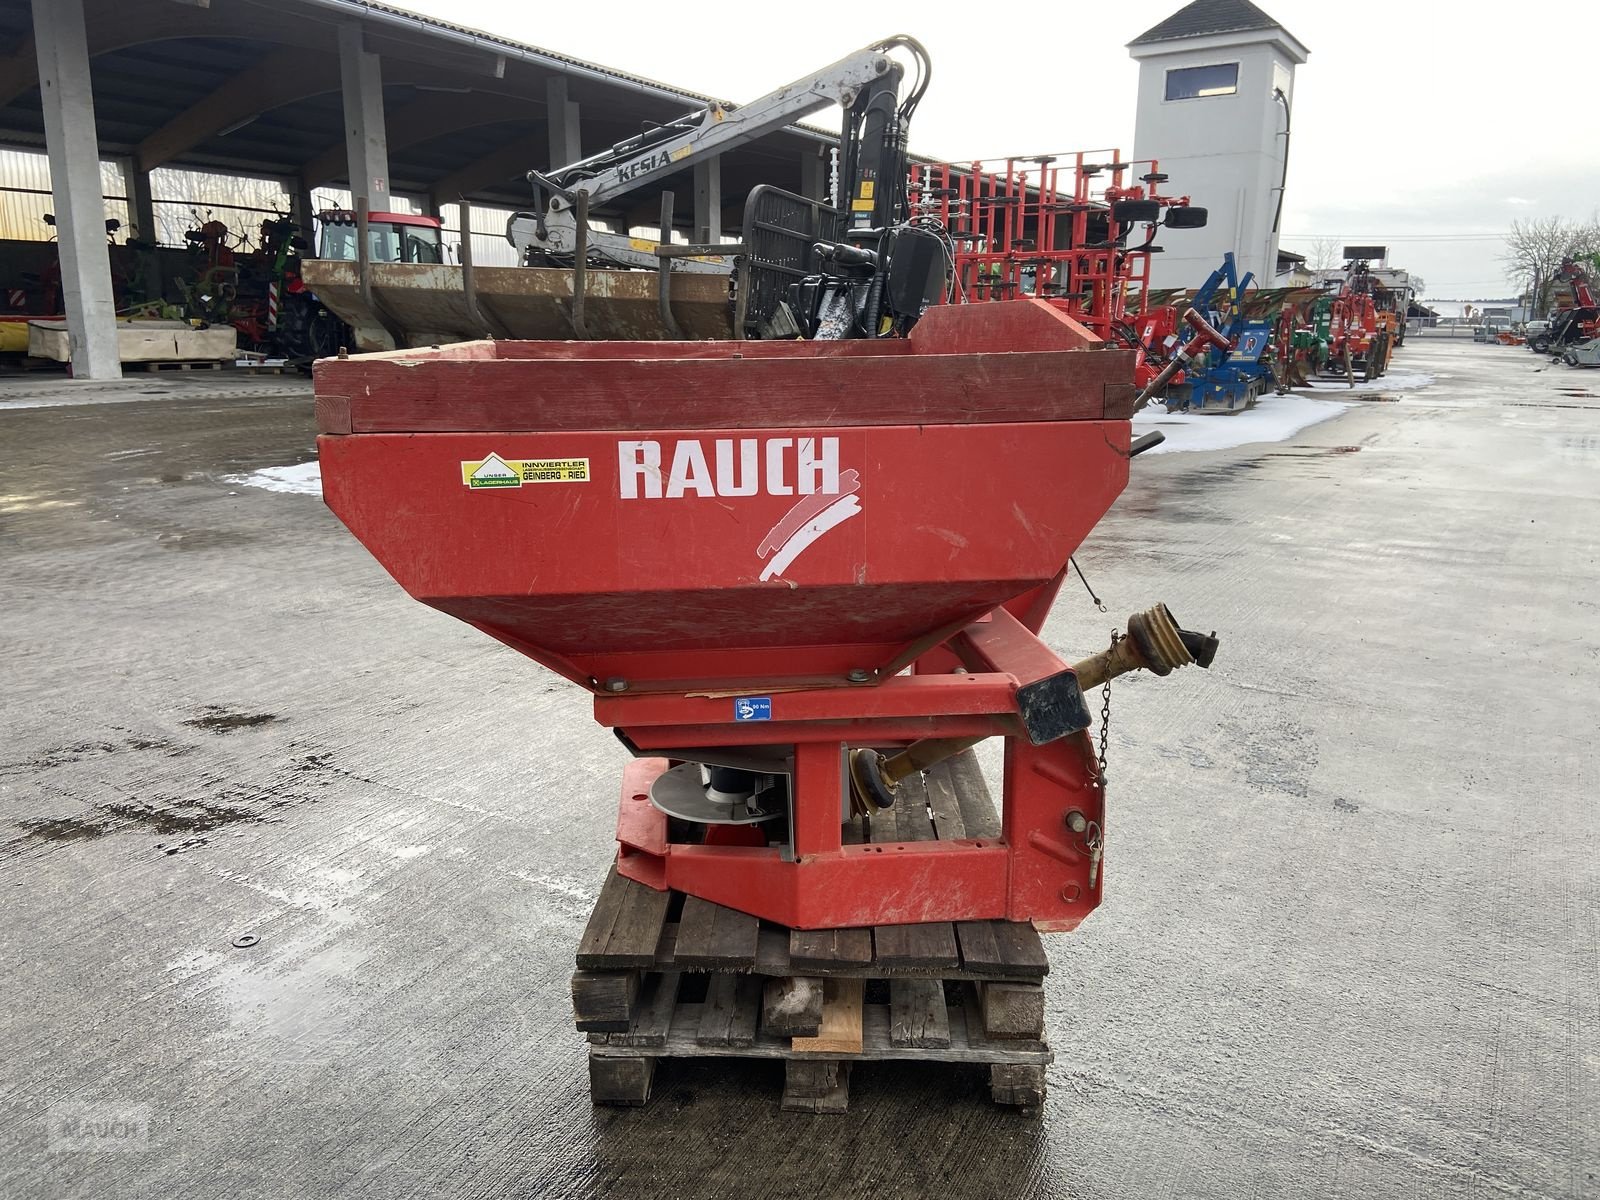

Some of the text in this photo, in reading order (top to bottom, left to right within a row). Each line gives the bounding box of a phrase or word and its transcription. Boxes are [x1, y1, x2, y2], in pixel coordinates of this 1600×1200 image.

[523, 471, 561, 480] GEINBERG
[568, 470, 586, 479] RIED
[618, 437, 840, 499] RAUCH
